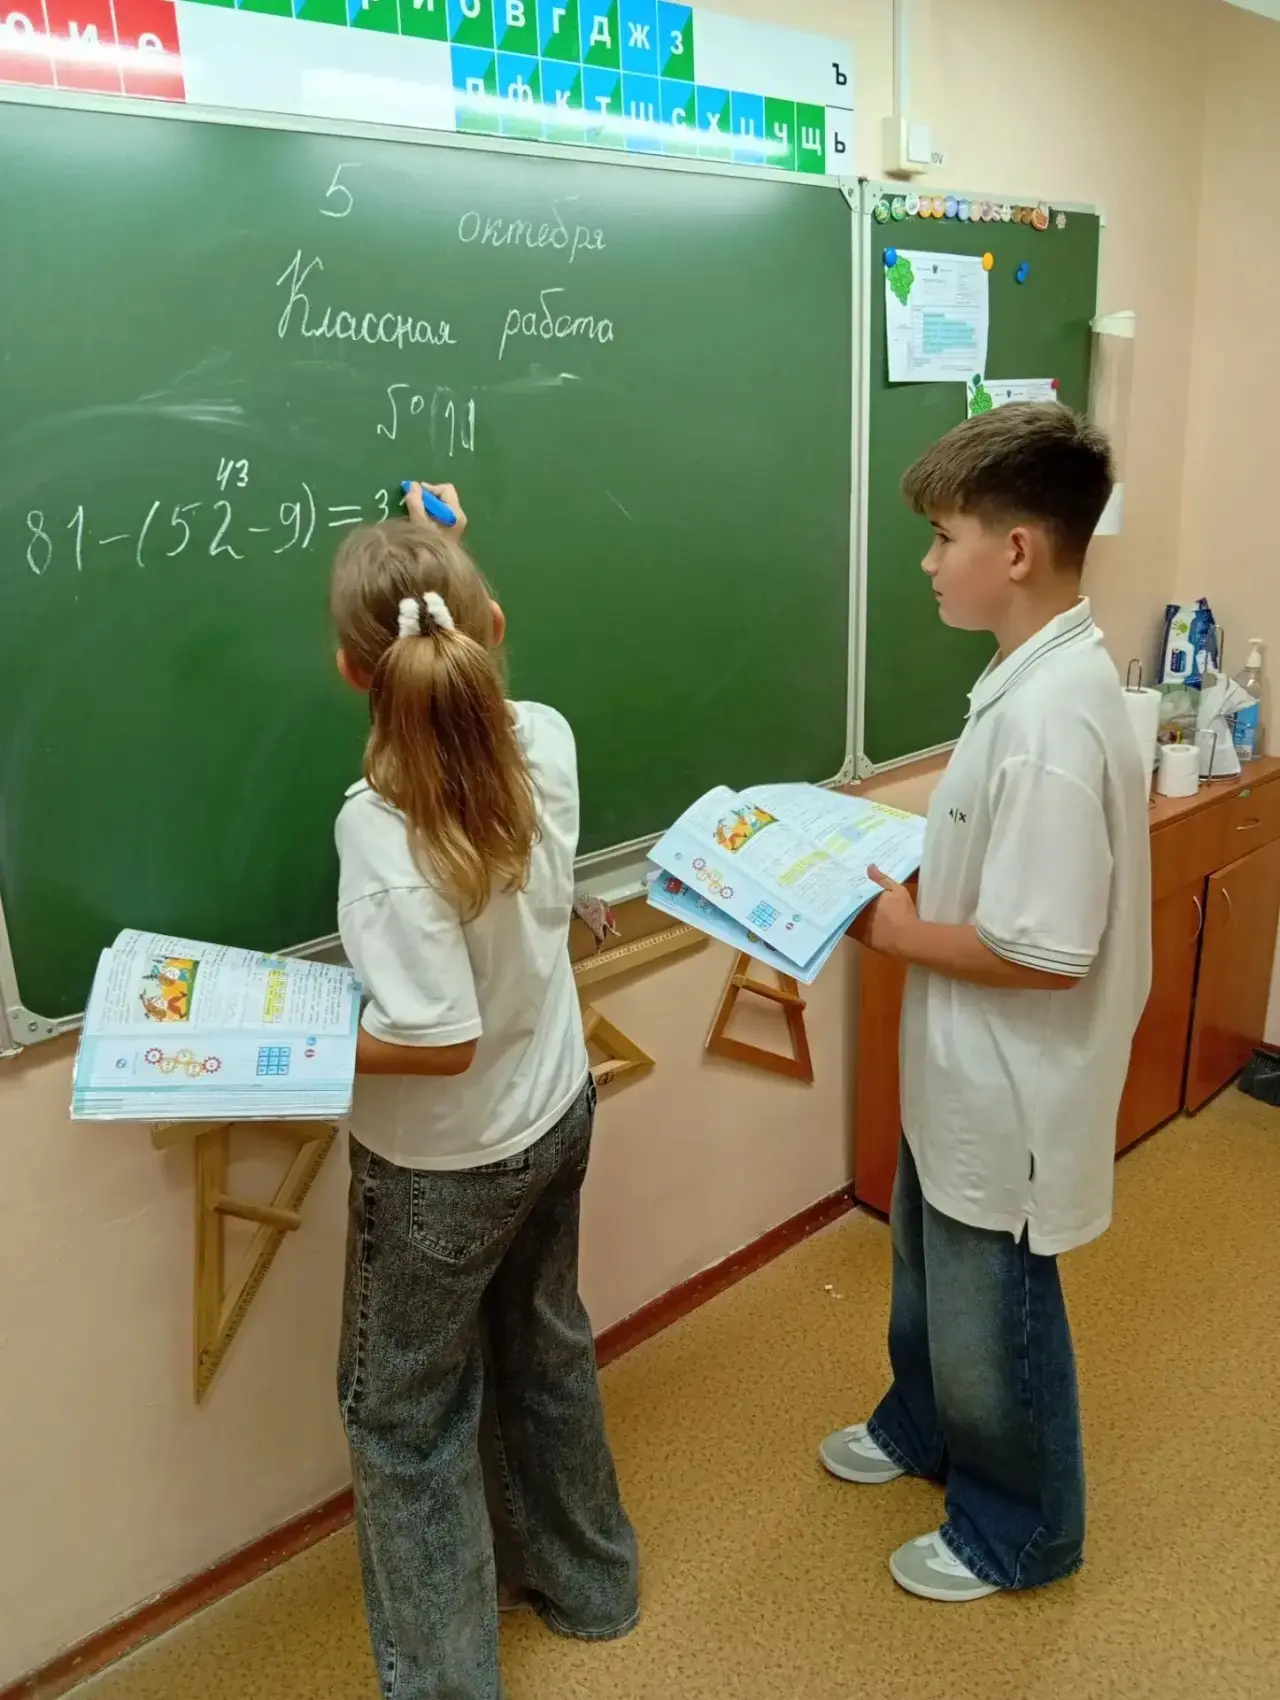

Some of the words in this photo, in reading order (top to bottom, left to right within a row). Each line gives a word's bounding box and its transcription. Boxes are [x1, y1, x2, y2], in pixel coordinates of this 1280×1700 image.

[318, 163, 362, 217] 5
[276, 249, 457, 349] Классная
[498, 287, 615, 361] работа
[215, 456, 250, 491] 43
